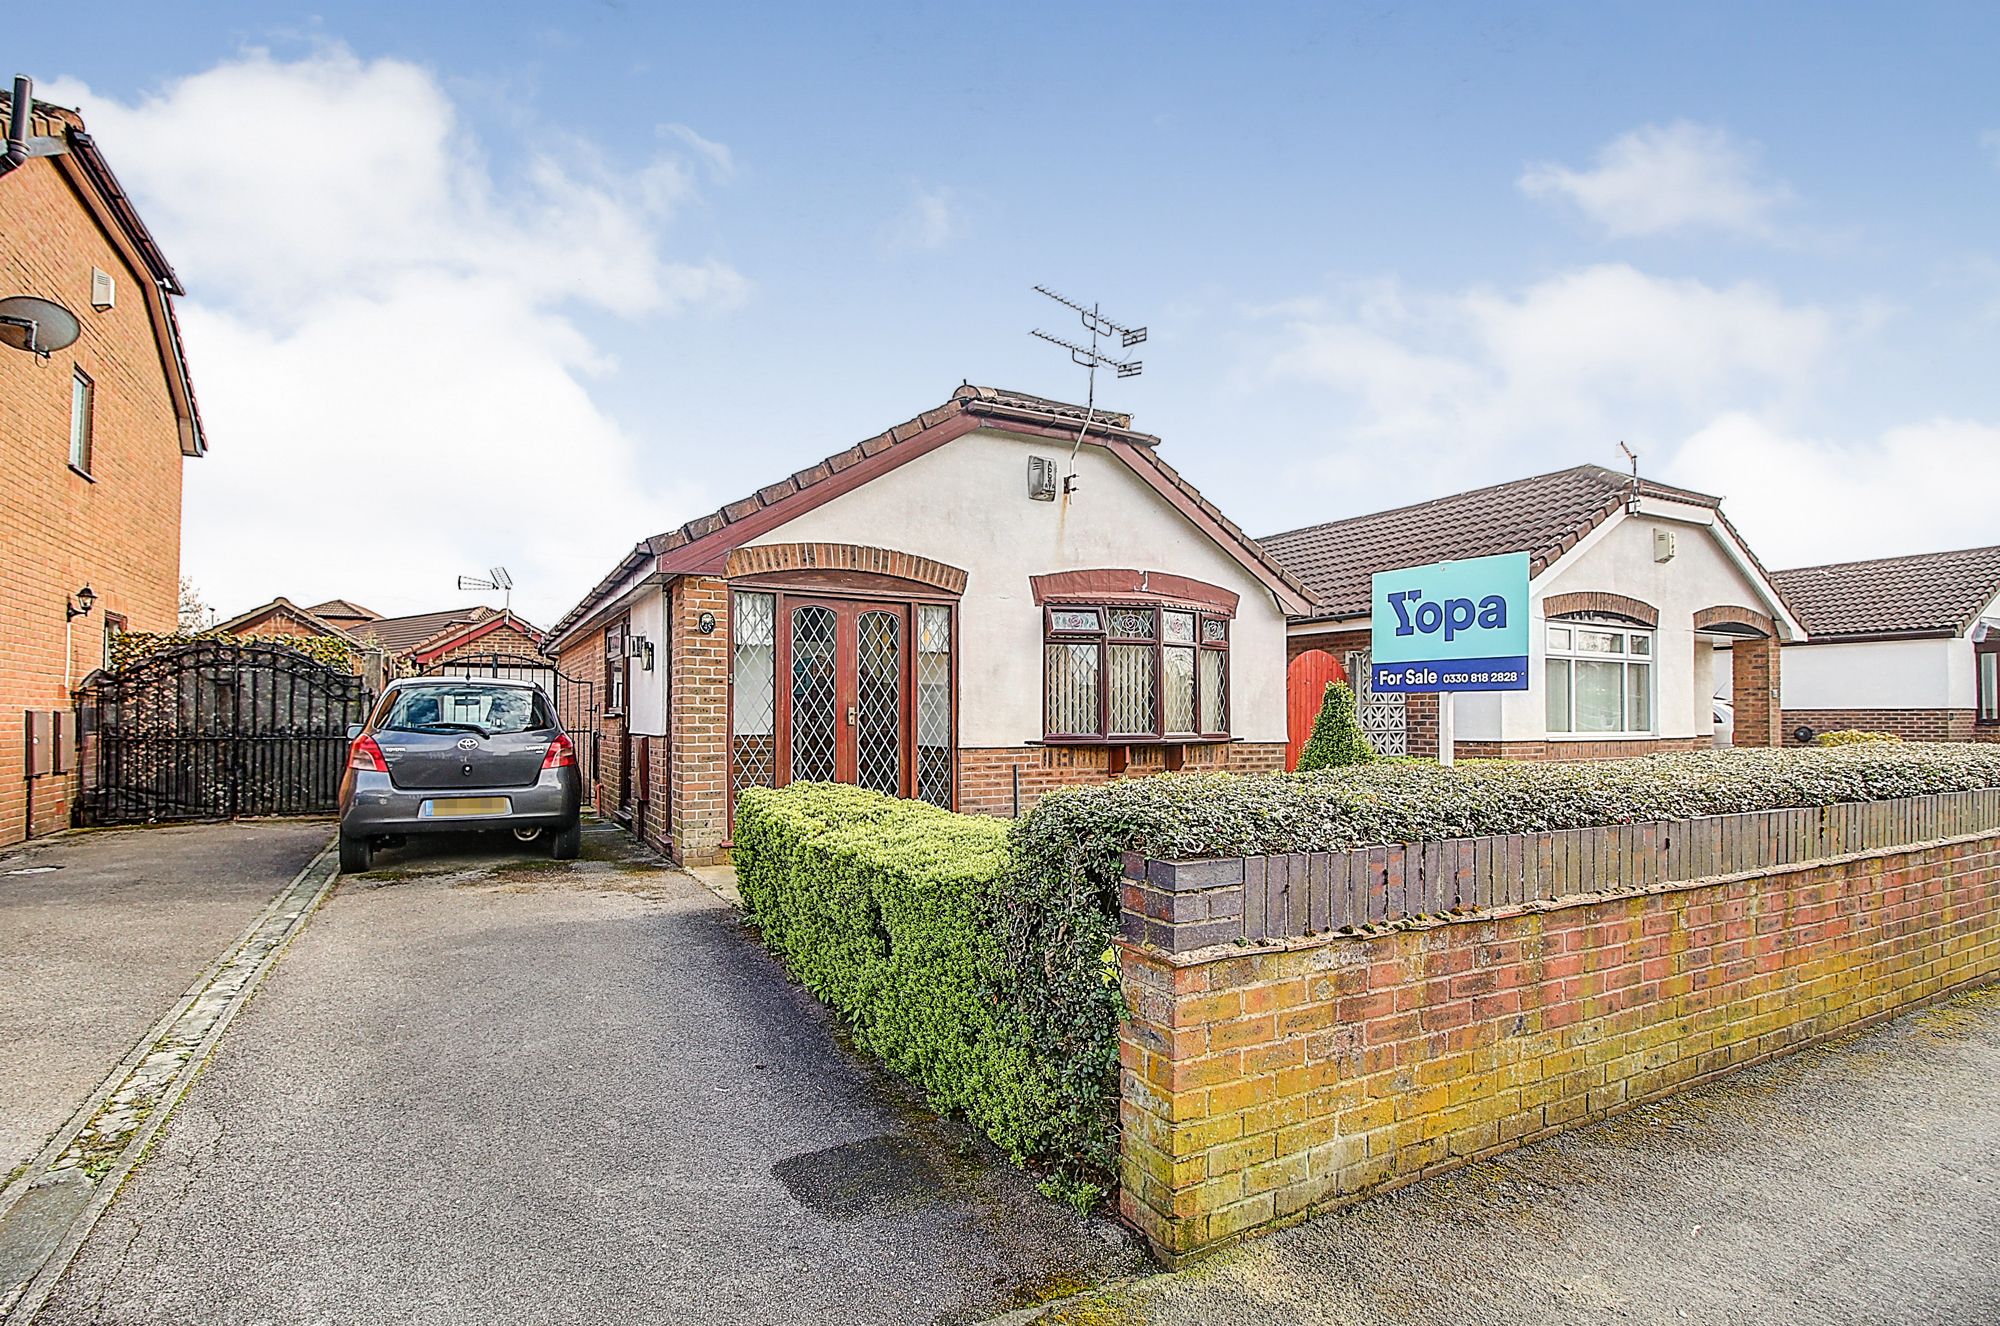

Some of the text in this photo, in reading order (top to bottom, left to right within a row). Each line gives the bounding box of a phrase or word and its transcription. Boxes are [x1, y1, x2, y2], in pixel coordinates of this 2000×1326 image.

[1387, 589, 1507, 642] Yopa
[1379, 668, 1518, 686] For Sale 0330 818 2828
